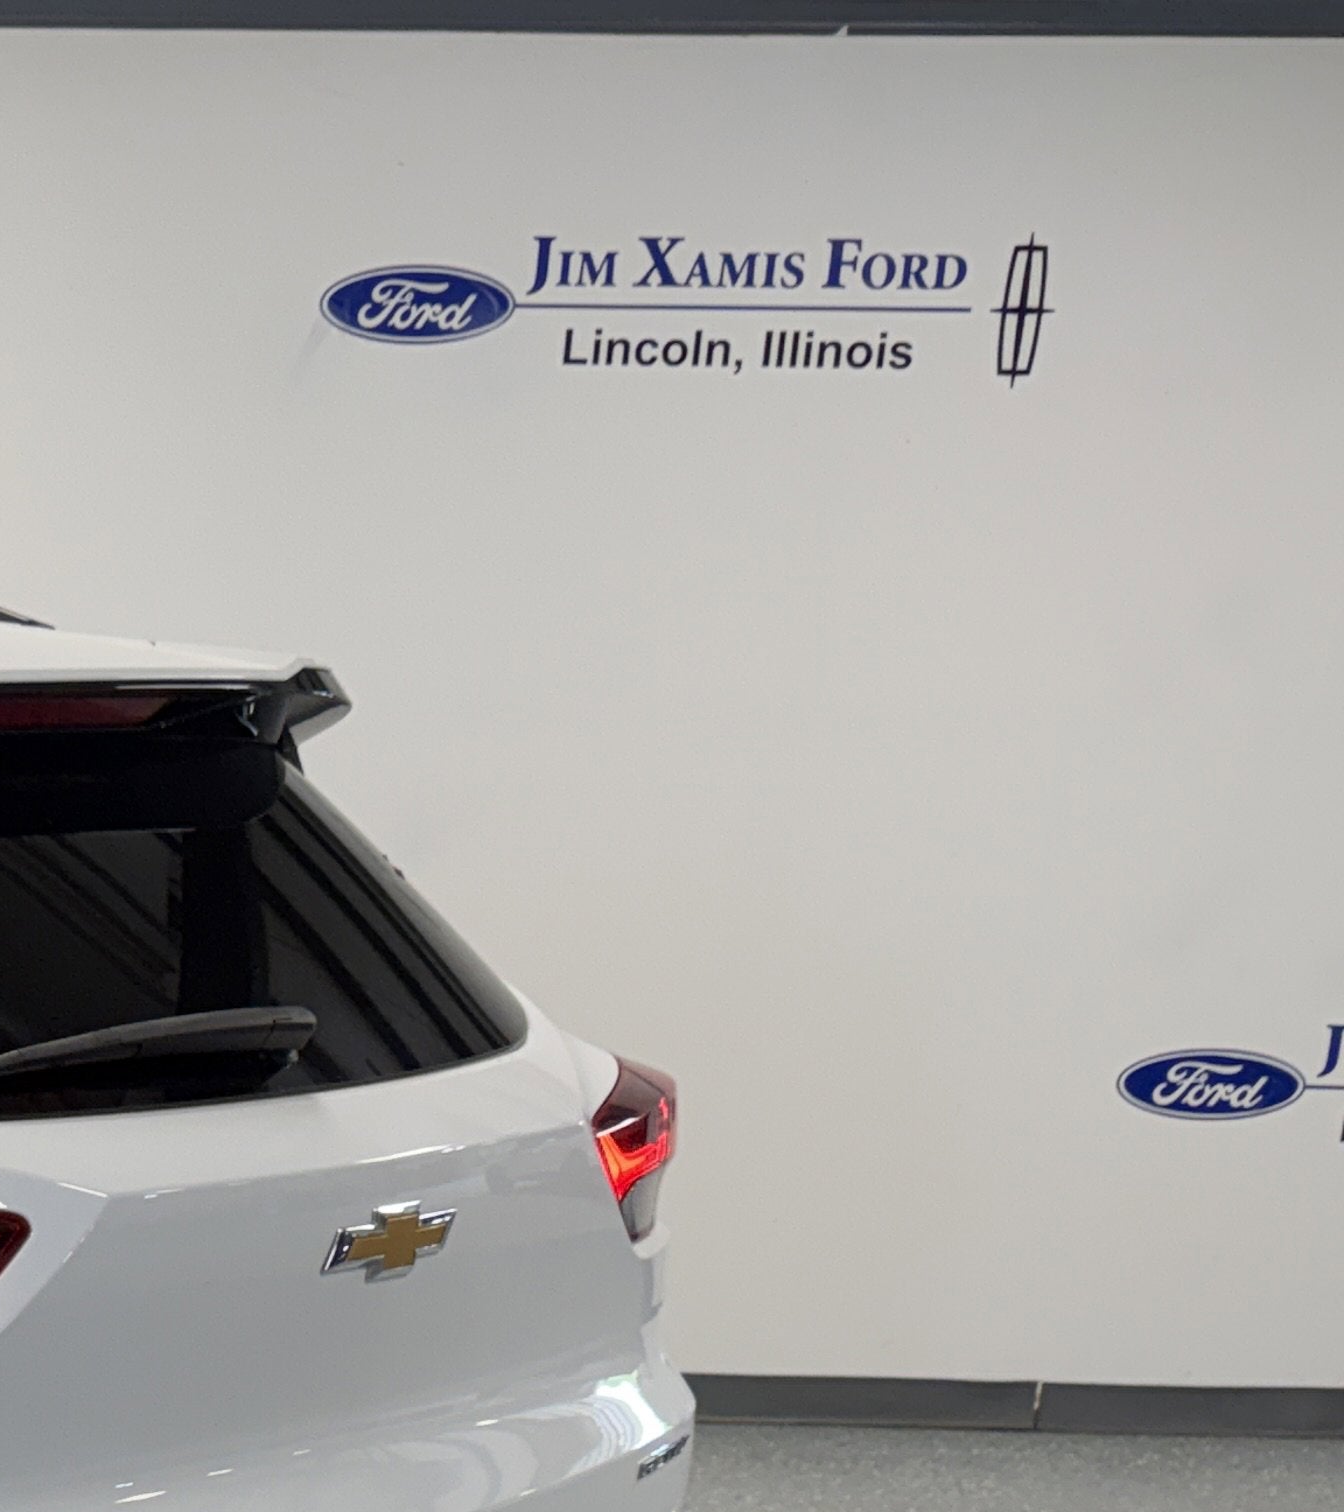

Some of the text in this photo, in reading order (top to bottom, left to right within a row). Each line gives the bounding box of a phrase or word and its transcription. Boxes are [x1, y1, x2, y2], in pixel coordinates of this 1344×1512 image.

[526, 235, 969, 296] JIM XAMIS FORD
[357, 280, 472, 332] Ford
[562, 329, 912, 374] Lincoln, Illinois
[1152, 1060, 1269, 1109] Ford
